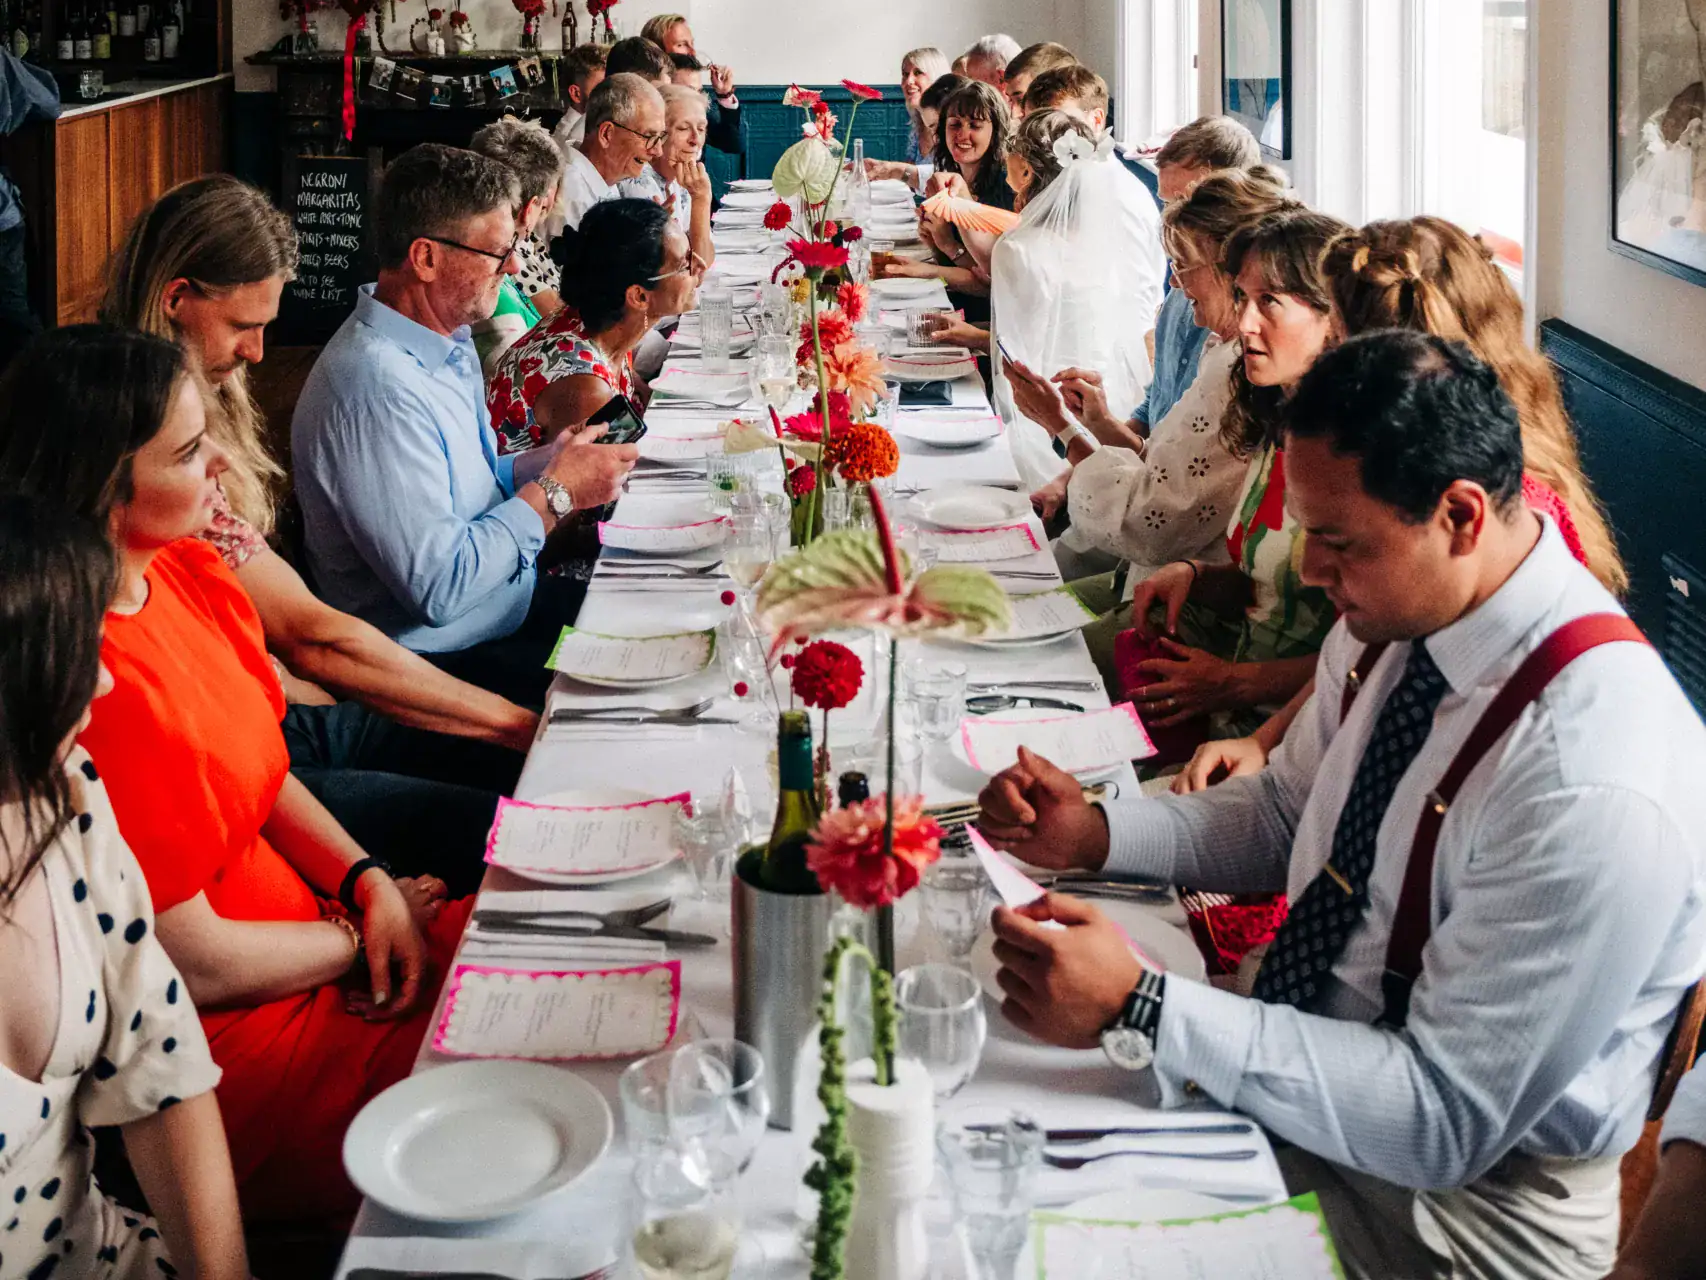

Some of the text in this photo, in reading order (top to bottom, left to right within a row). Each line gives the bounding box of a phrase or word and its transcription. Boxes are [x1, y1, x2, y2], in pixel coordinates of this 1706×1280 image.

[301, 172, 348, 189] NEGRONI
[297, 191, 361, 211] MARGARITAS
[297, 211, 317, 224] WHITE
[324, 253, 349, 269] BEERS
[308, 275, 318, 286] TO
[320, 274, 336, 288] SEE
[321, 288, 347, 301] LIST
